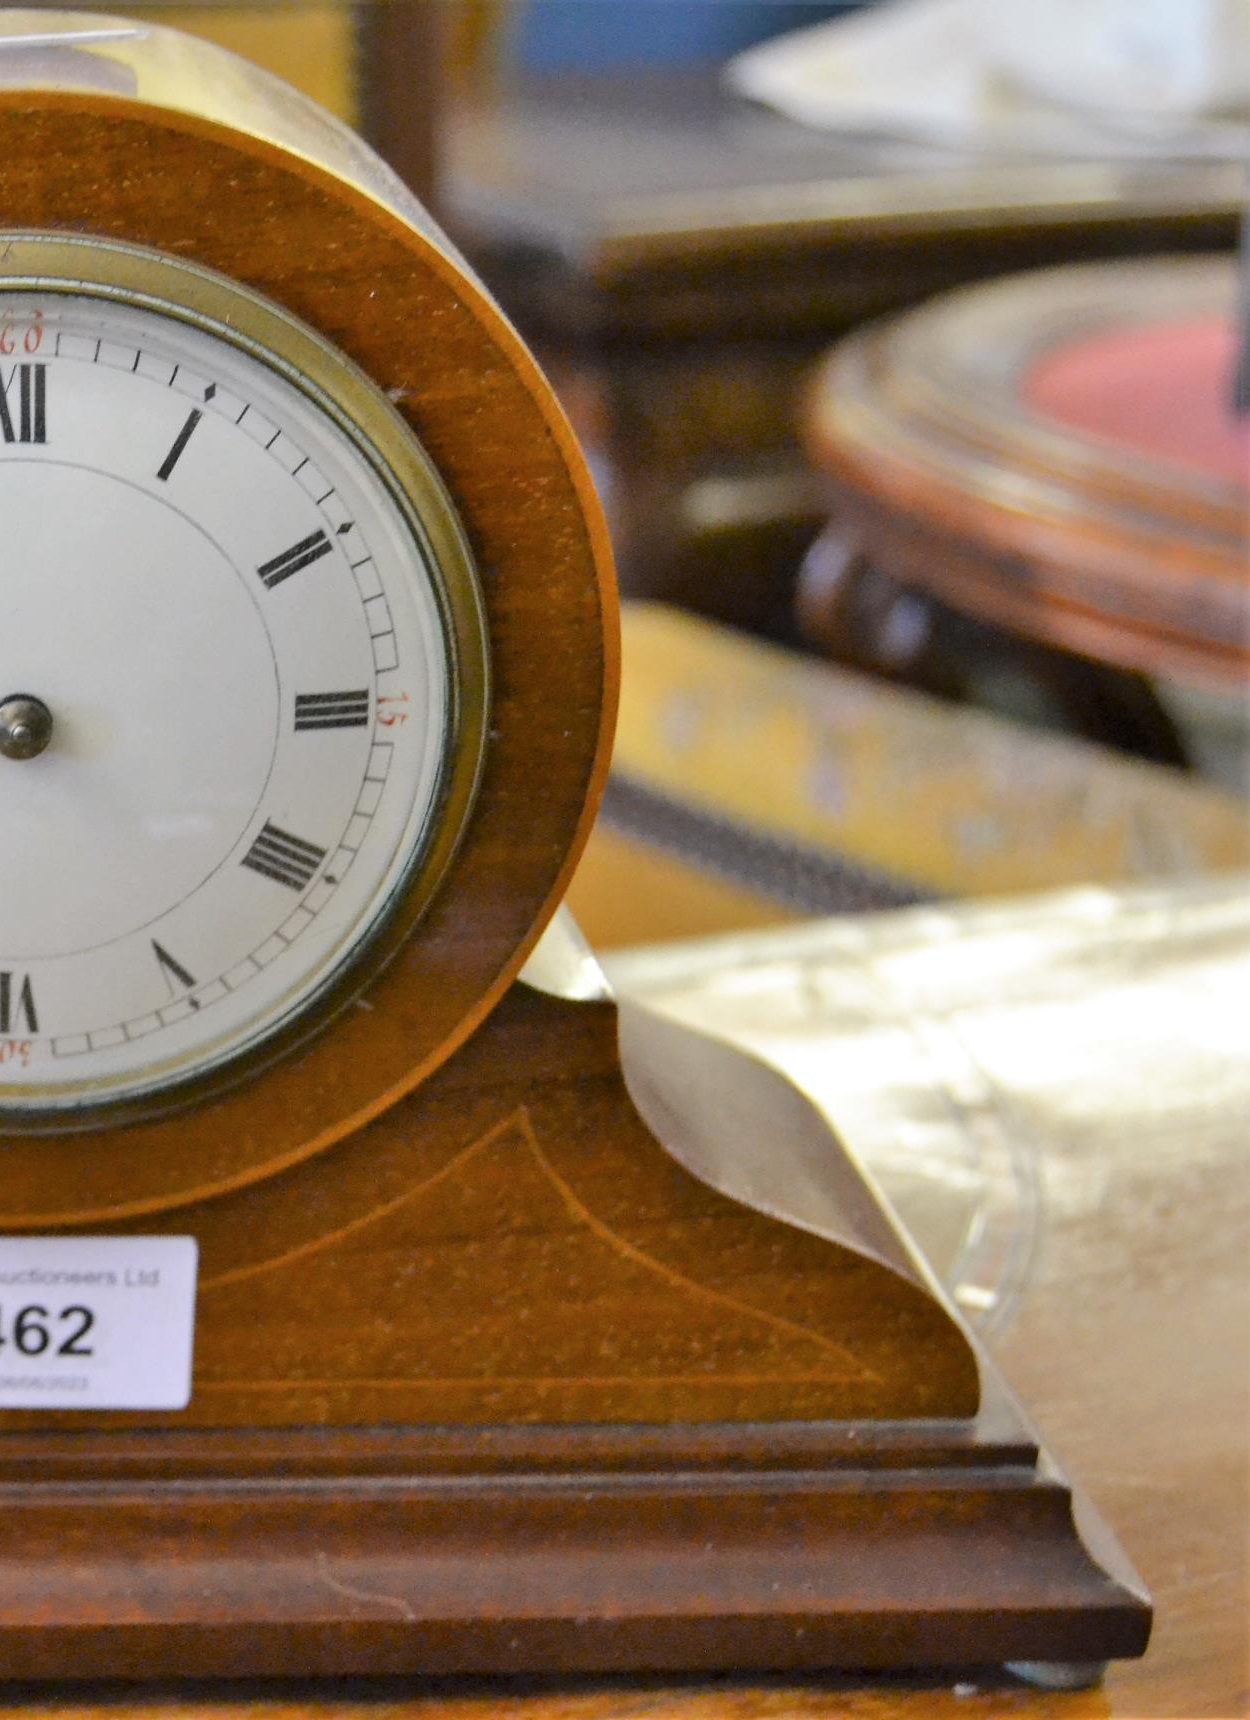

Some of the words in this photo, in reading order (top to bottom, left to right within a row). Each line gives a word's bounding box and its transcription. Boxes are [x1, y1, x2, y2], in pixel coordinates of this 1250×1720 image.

[0, 306, 43, 354] 60
[258, 529, 334, 590] II
[295, 687, 369, 732] III
[377, 691, 411, 726] 15
[151, 938, 196, 995] V
[125, 1267, 159, 1287] Ltd
